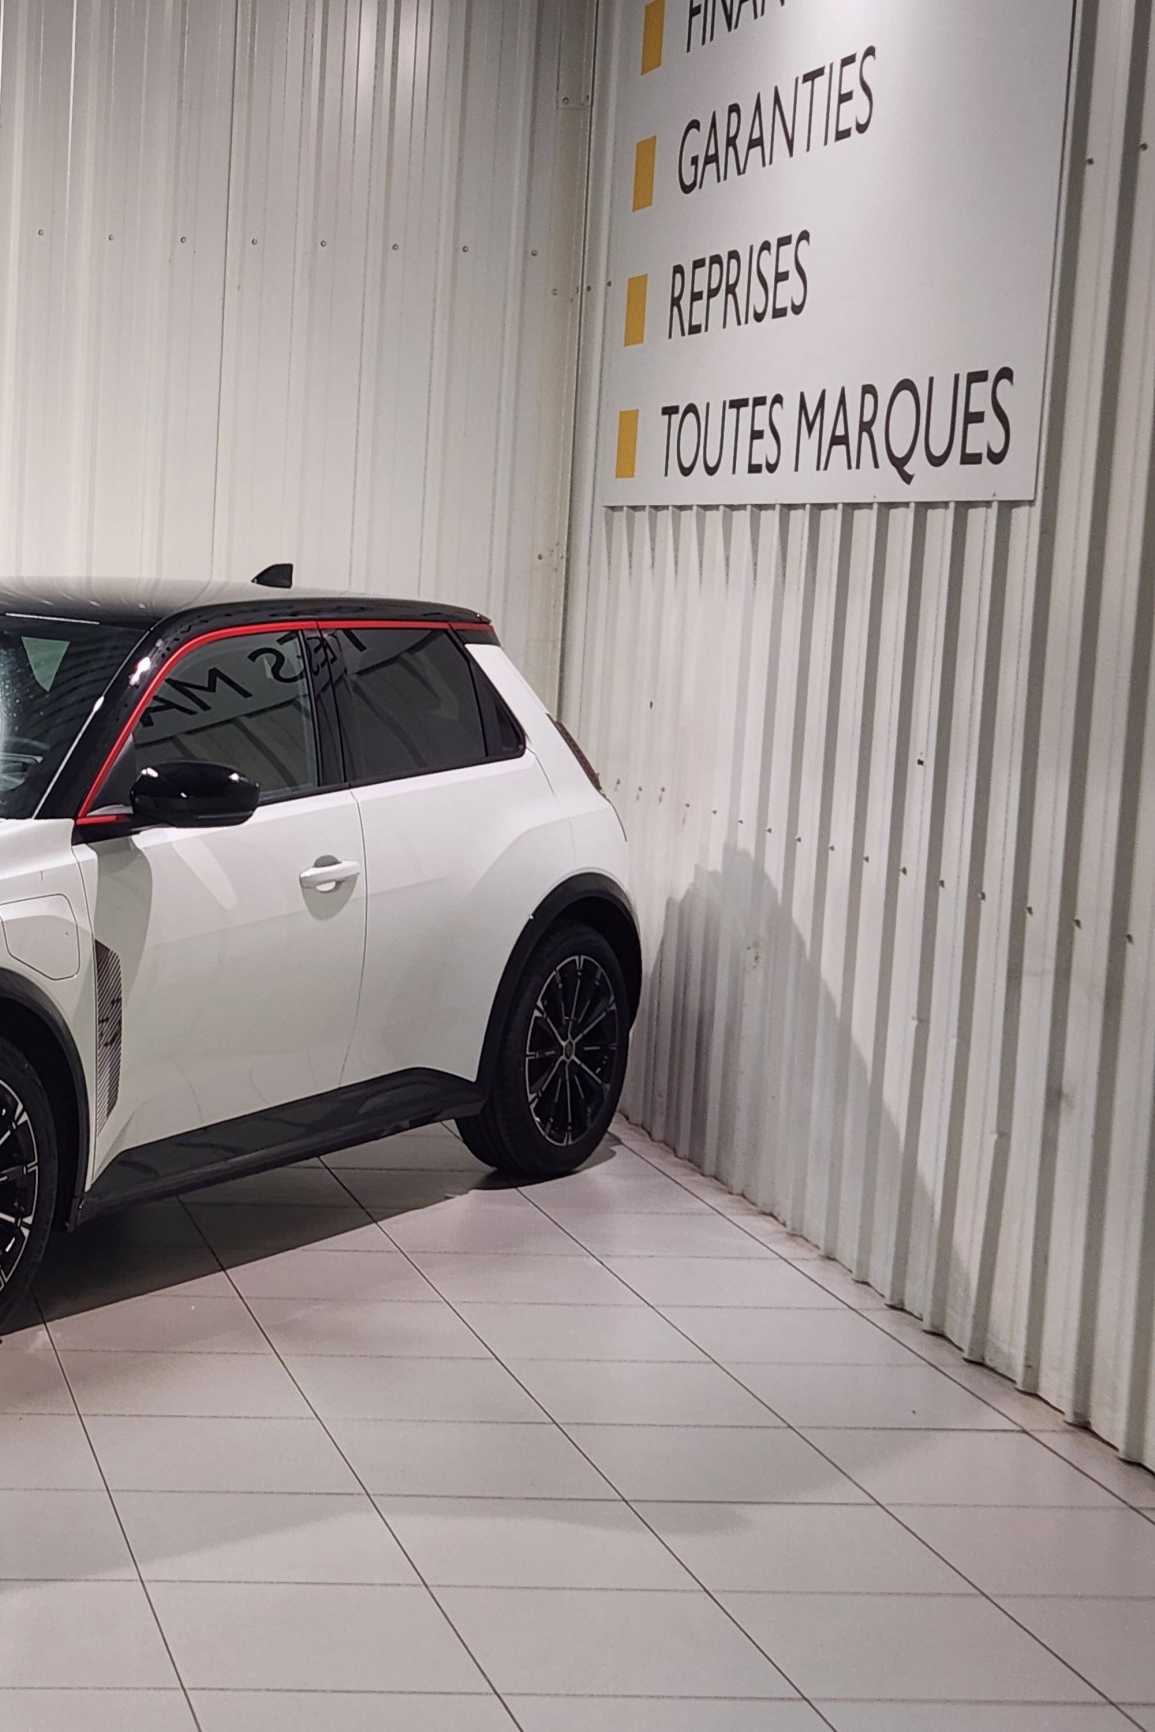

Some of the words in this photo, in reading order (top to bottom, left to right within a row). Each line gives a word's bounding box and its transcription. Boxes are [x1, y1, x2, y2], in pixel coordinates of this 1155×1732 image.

[686, 0, 785, 53] FIN
[677, 45, 876, 195] GARANTIES
[667, 229, 811, 340] REPRISES
[661, 393, 784, 478] TOUTES
[794, 366, 1015, 486] MARQUES
